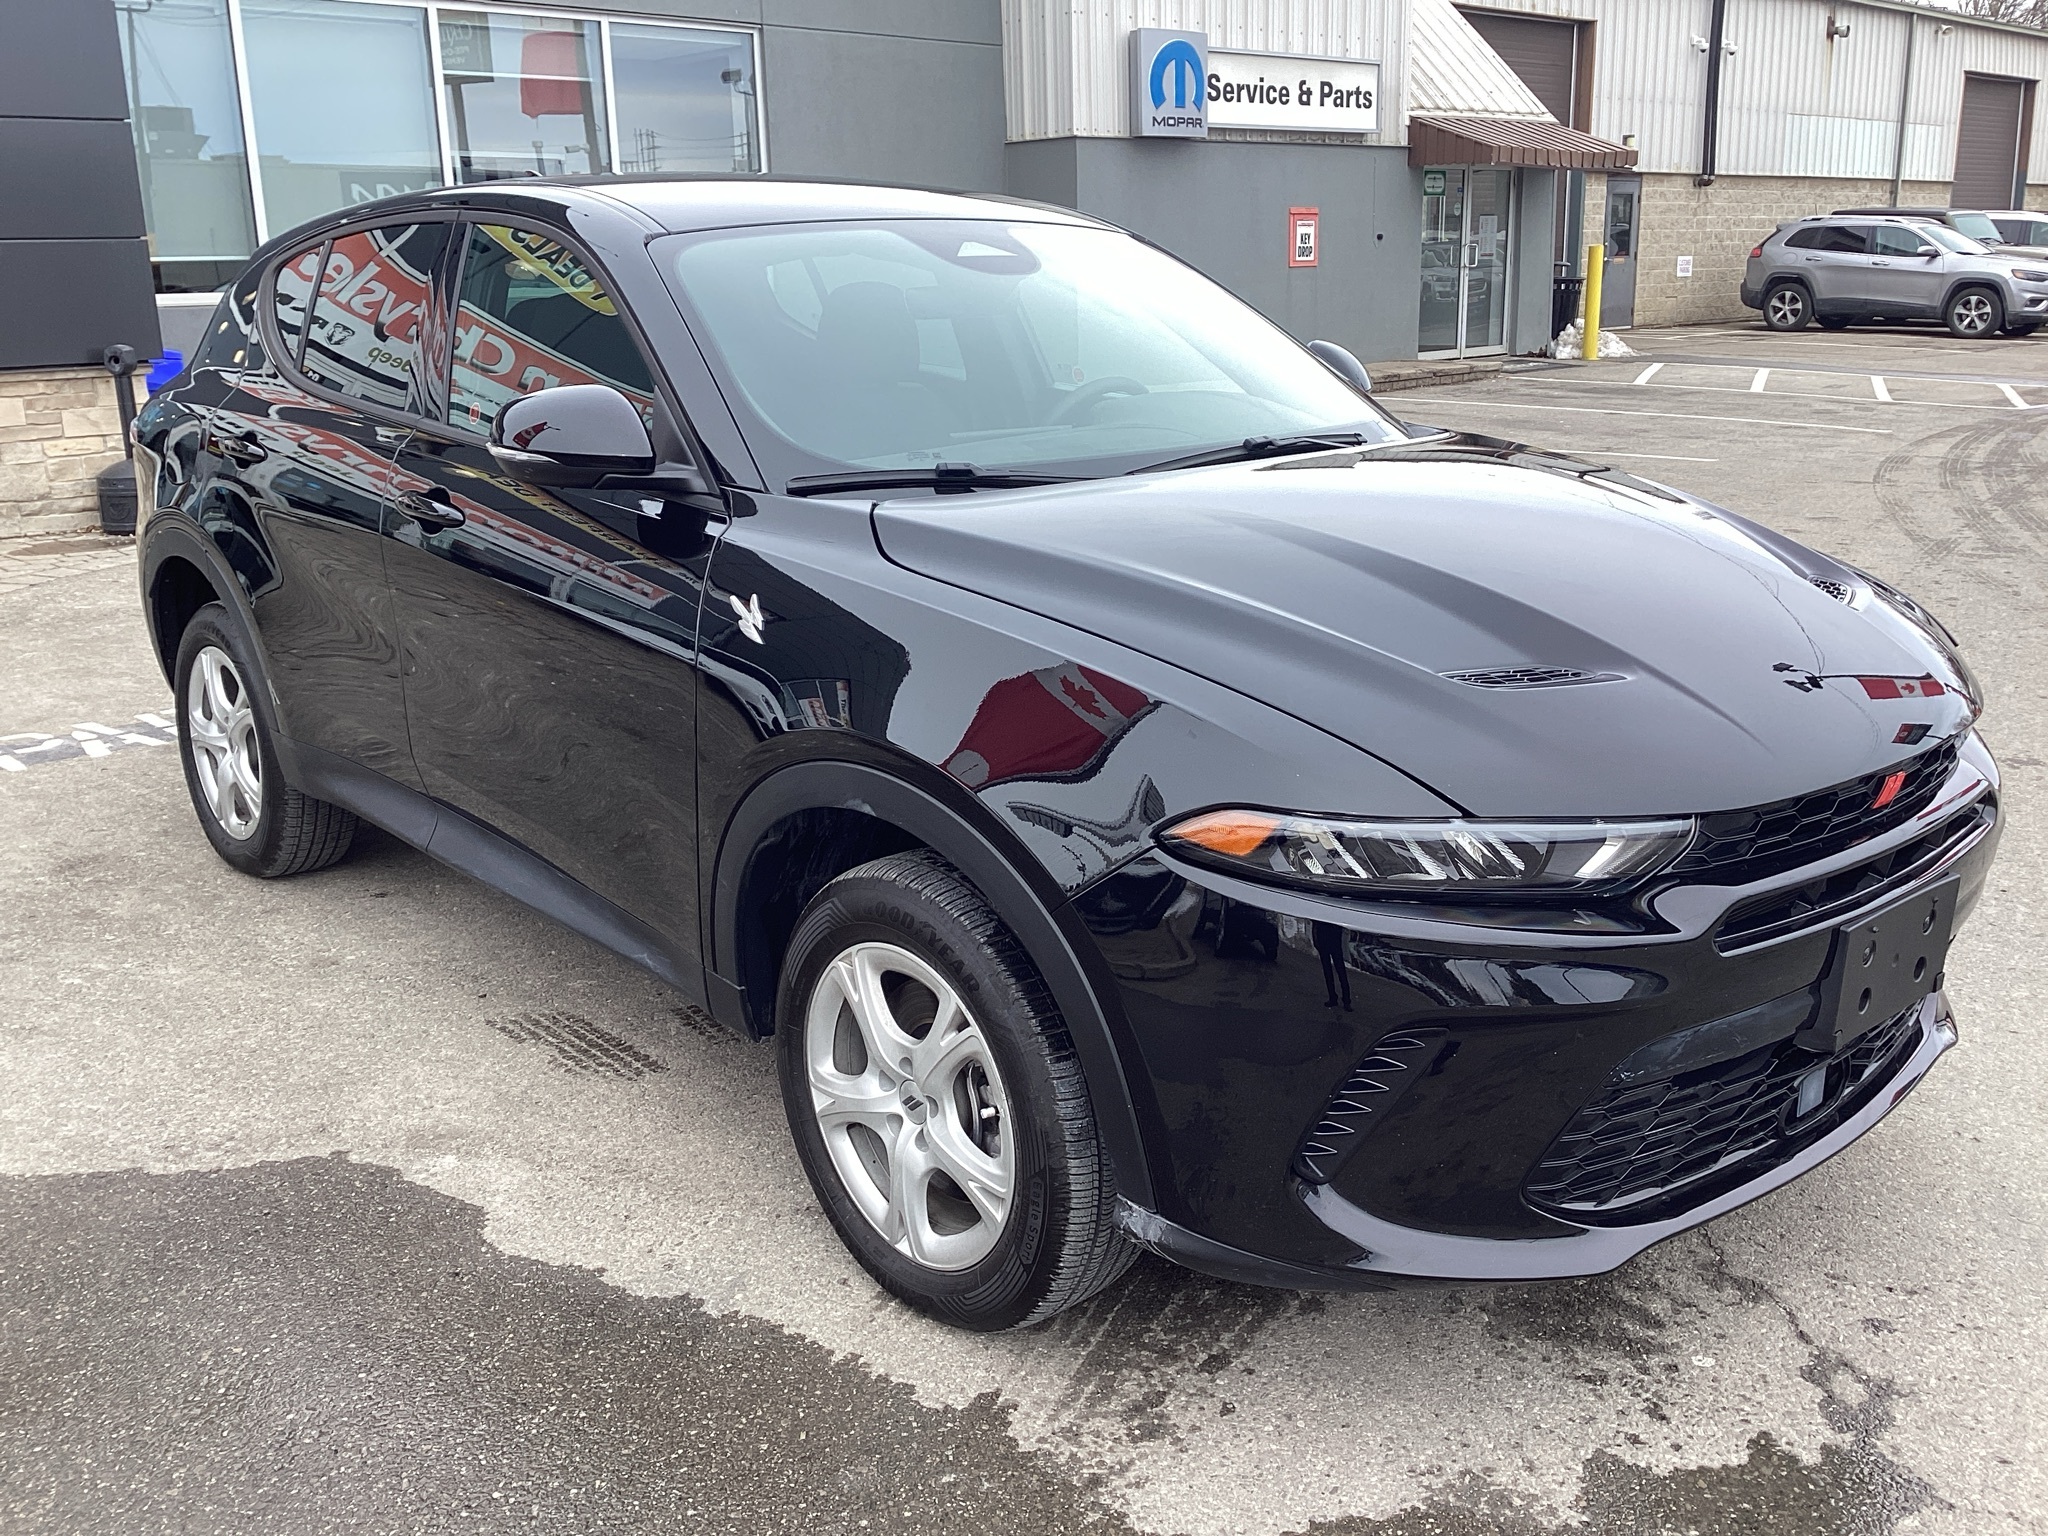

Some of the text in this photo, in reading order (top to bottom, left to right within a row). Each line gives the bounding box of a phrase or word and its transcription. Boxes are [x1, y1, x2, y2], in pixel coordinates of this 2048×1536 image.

[1207, 73, 1373, 109] Service & Parts
[1152, 116, 1203, 129] MOPAR
[1300, 233, 1311, 245] KEY
[1297, 245, 1313, 258] DROP
[1030, 1181, 1043, 1221] Eagle
[1021, 1225, 1039, 1261] Sport
